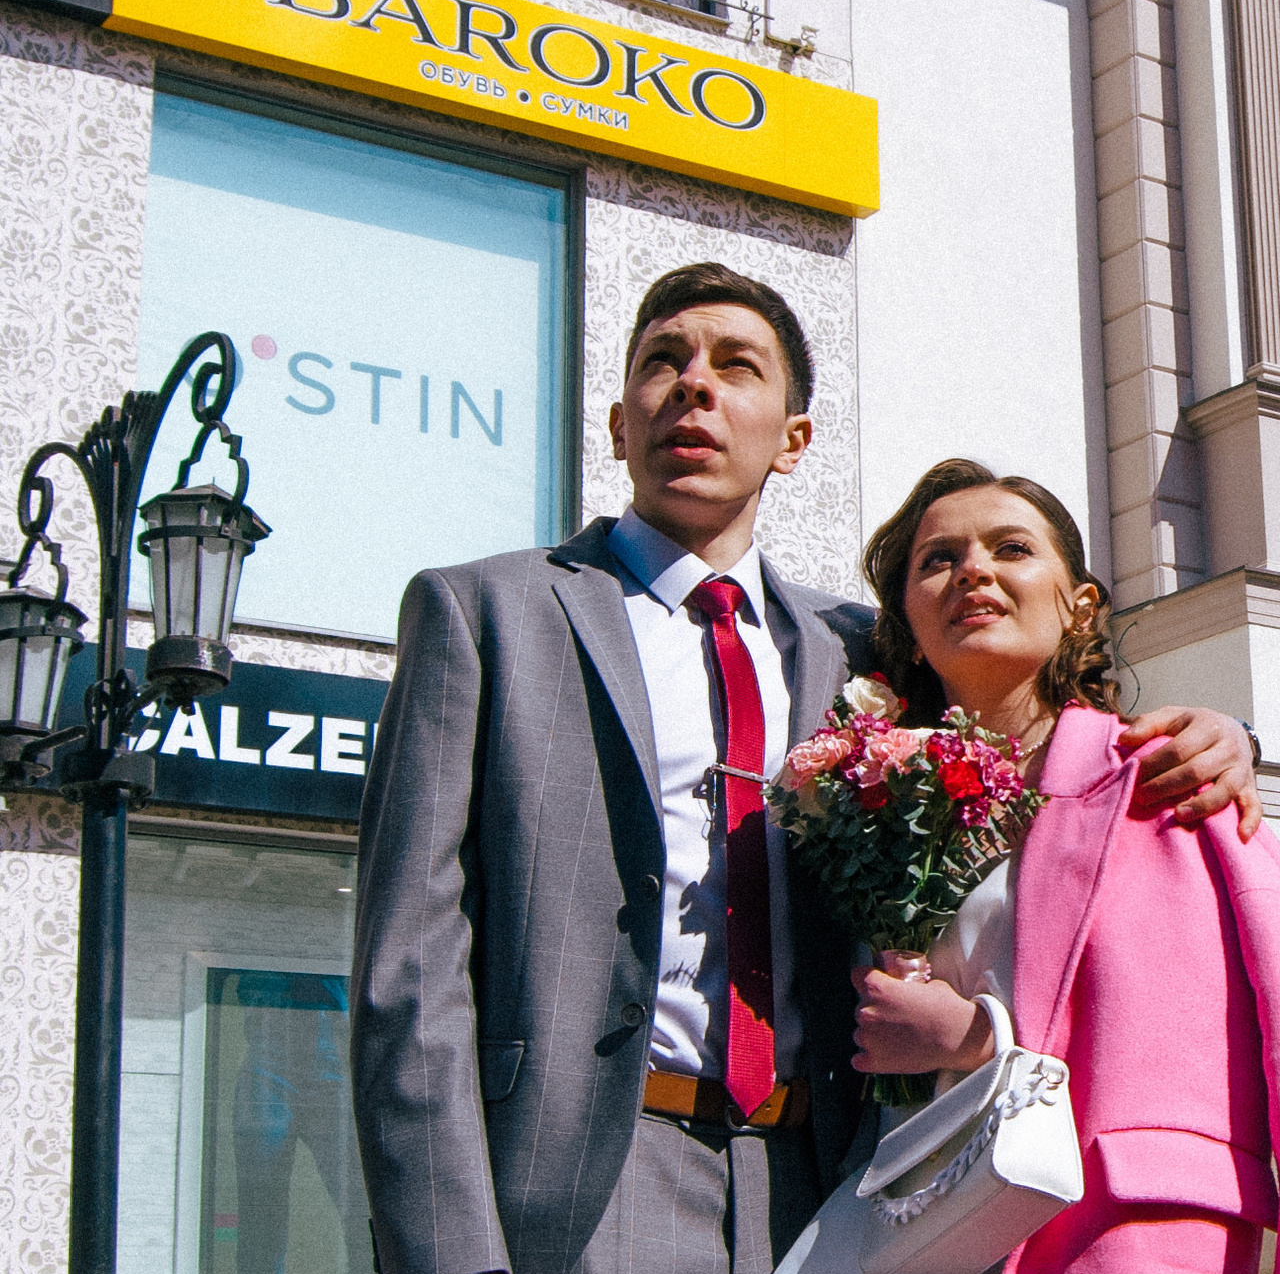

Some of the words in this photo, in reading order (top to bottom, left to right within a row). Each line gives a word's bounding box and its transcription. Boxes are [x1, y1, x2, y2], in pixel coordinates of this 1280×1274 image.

[418, 58, 508, 100] ОБУВЬ
[540, 91, 631, 131] СУМКИ
[127, 700, 381, 775] CALZE
